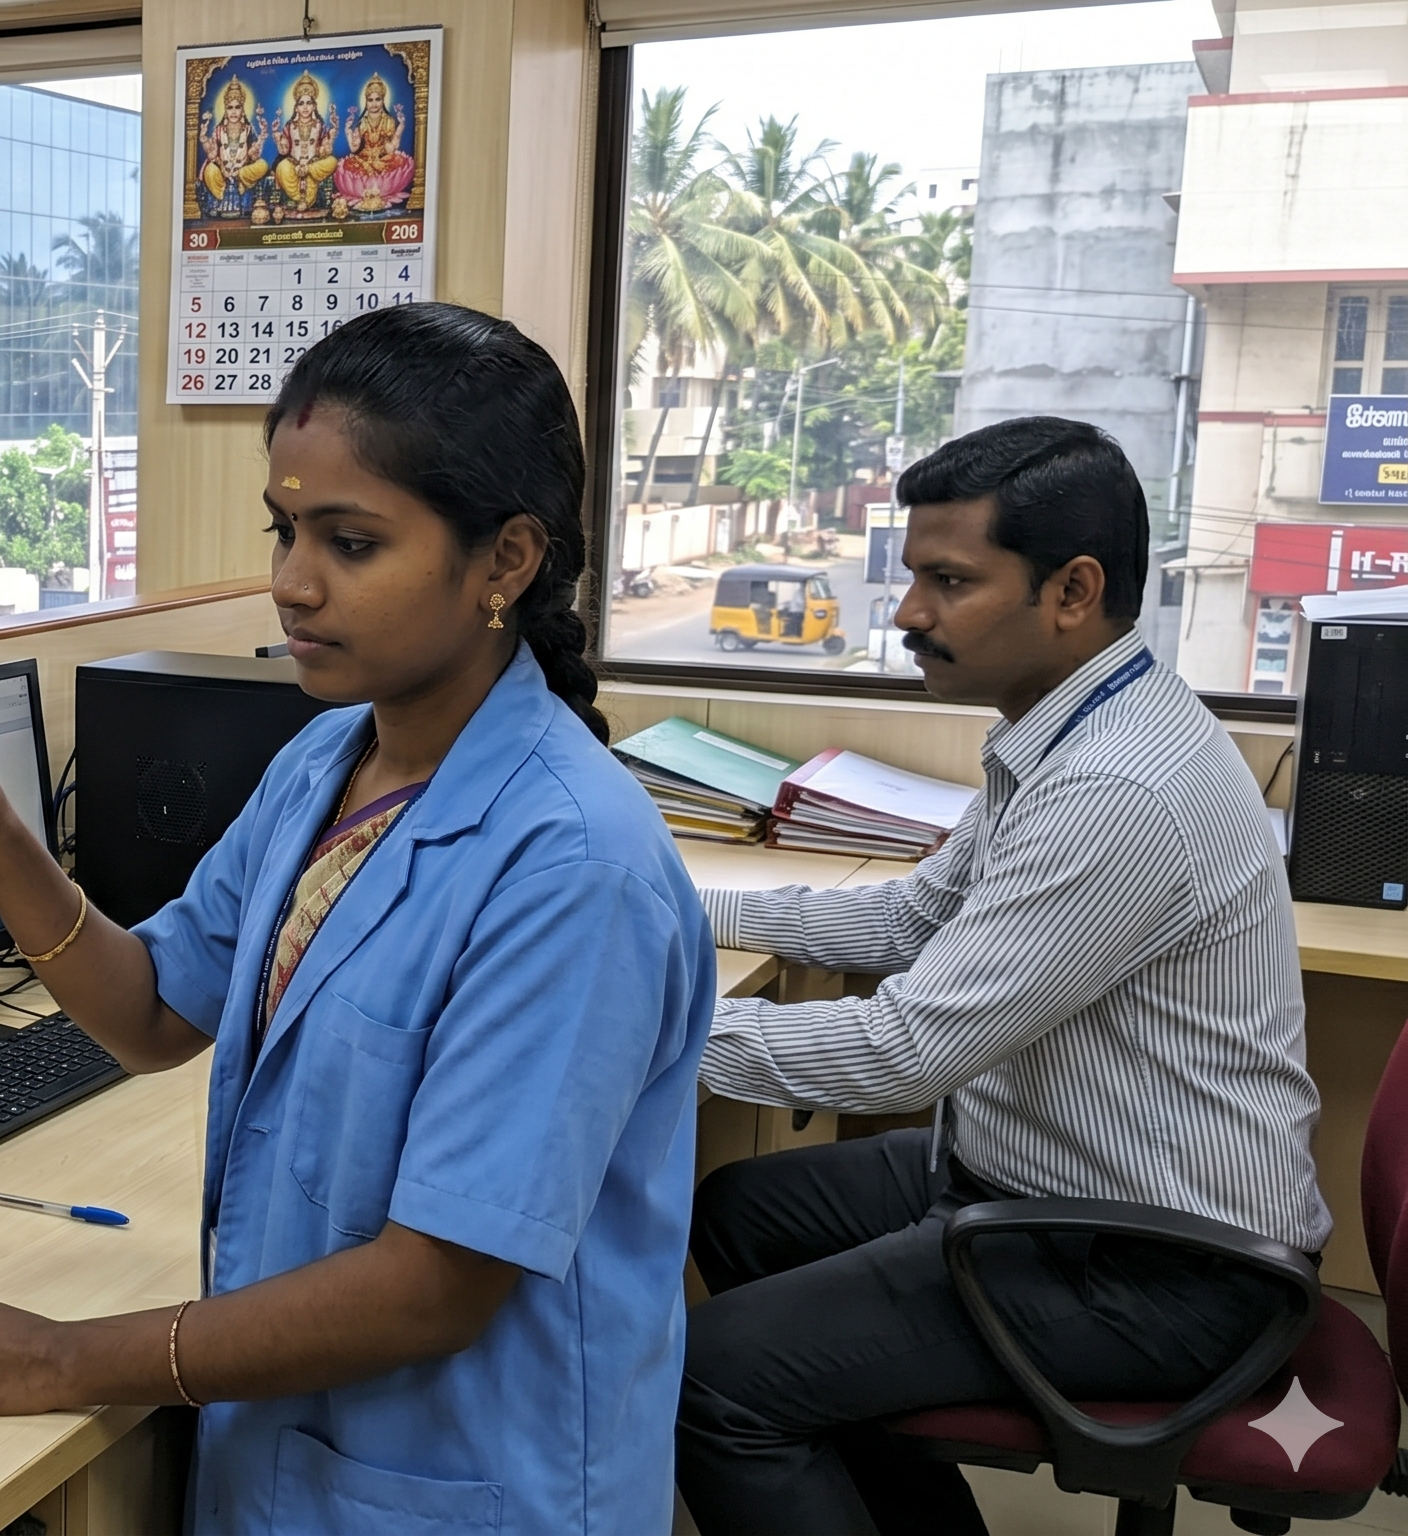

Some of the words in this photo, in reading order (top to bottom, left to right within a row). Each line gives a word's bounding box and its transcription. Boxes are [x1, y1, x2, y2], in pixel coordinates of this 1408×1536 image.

[189, 233, 208, 247] 30
[293, 268, 302, 285] 1
[327, 267, 339, 284] 2
[363, 266, 374, 283] 3
[398, 265, 410, 281] 4
[191, 297, 201, 312] 5
[224, 296, 235, 312] 6
[258, 296, 269, 312] 7
[292, 295, 303, 311] 8
[326, 294, 338, 310] 9
[356, 293, 379, 310] 10
[392, 292, 413, 306] 11
[185, 322, 207, 339] 12
[217, 322, 240, 338] 13
[251, 321, 274, 338] 14
[285, 320, 309, 337] 15
[183, 348, 206, 364] 19
[215, 348, 239, 364] 20
[249, 347, 270, 364] 21
[181, 374, 204, 391] 26
[214, 374, 238, 391] 27
[248, 374, 271, 390] 28
